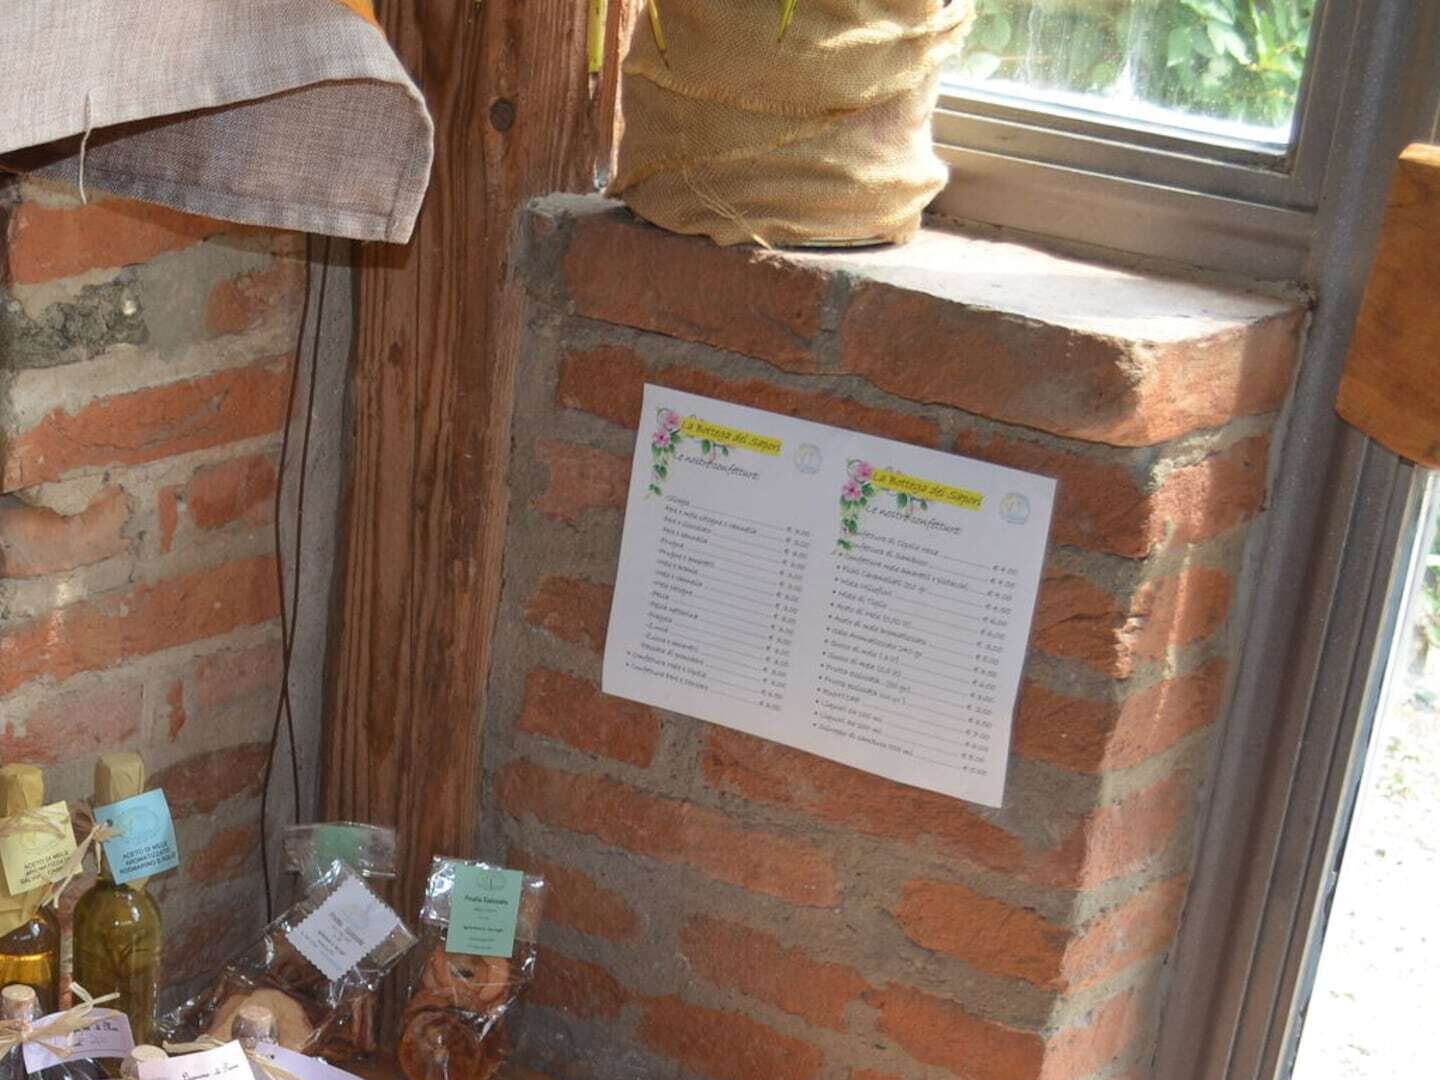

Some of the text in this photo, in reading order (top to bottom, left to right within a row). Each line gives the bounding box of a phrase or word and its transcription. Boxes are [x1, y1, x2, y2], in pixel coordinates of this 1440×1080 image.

[694, 422, 731, 440] Bottega
[888, 474, 929, 494] Bottega
[947, 489, 982, 509] Sapori
[878, 507, 907, 521] nostre
